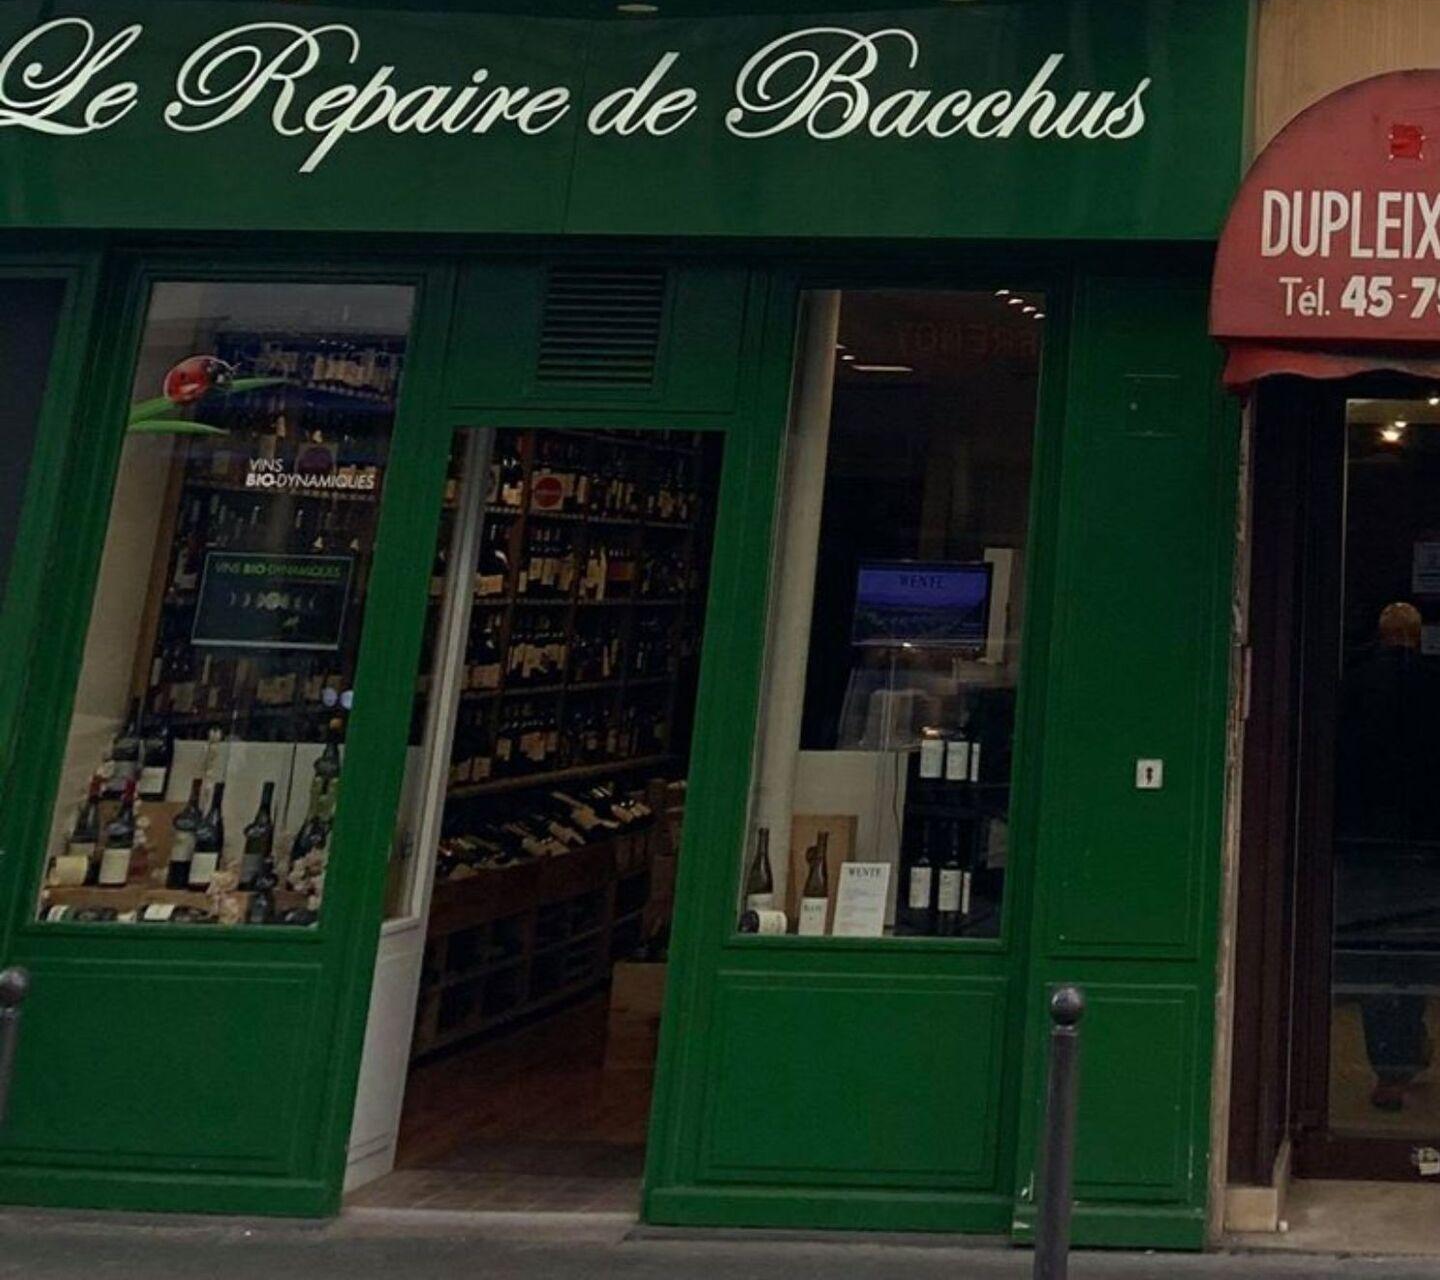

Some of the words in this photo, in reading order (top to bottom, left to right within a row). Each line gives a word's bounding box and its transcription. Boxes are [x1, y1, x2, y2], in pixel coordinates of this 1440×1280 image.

[0, 17, 143, 135] Le
[165, 22, 570, 173] Repaire
[588, 52, 697, 136] de
[726, 27, 1151, 140] Bacchus
[1279, 276, 1331, 317] Tél.
[250, 458, 283, 472] VINS
[246, 473, 375, 490] BIO-DYNAMIQUES
